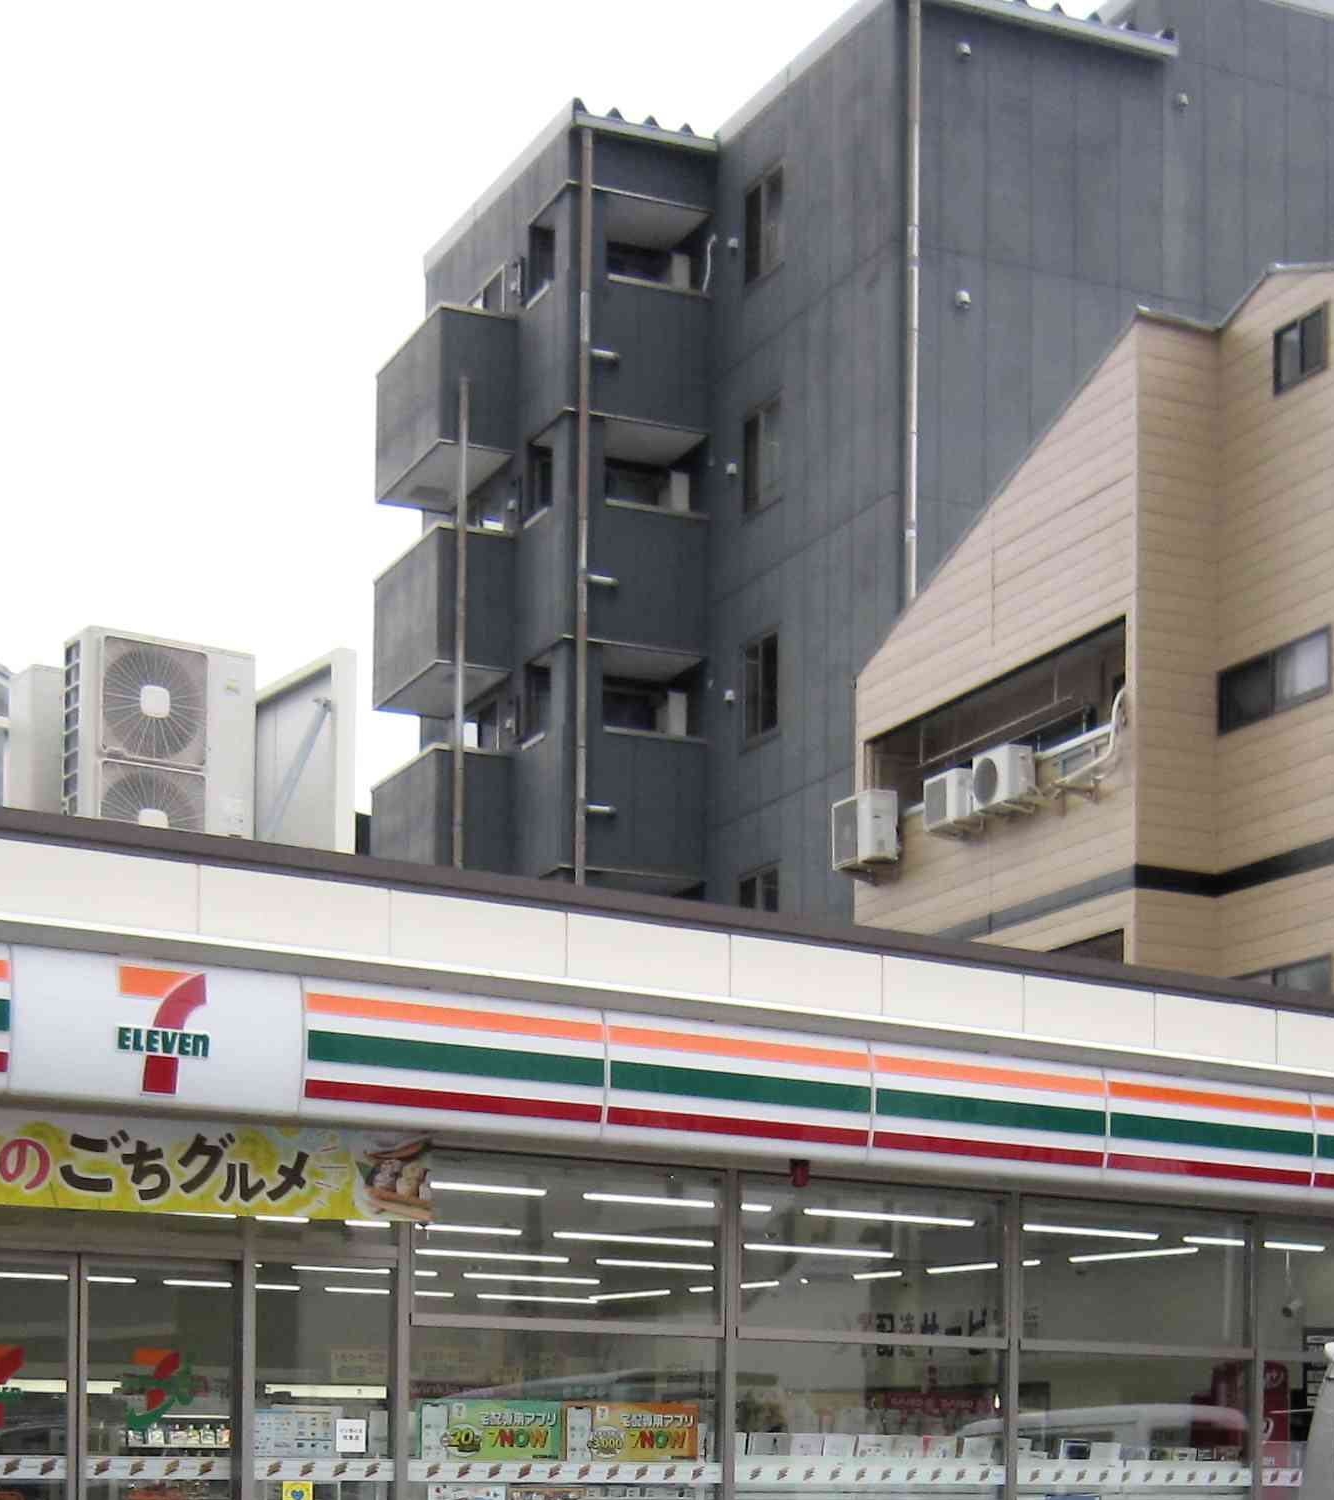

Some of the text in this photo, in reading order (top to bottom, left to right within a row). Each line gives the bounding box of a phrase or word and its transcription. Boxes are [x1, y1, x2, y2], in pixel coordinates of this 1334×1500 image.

[480, 1411, 557, 1428] 宅配専用アプリ
[620, 1413, 695, 1429] 宅配専用アプリ
